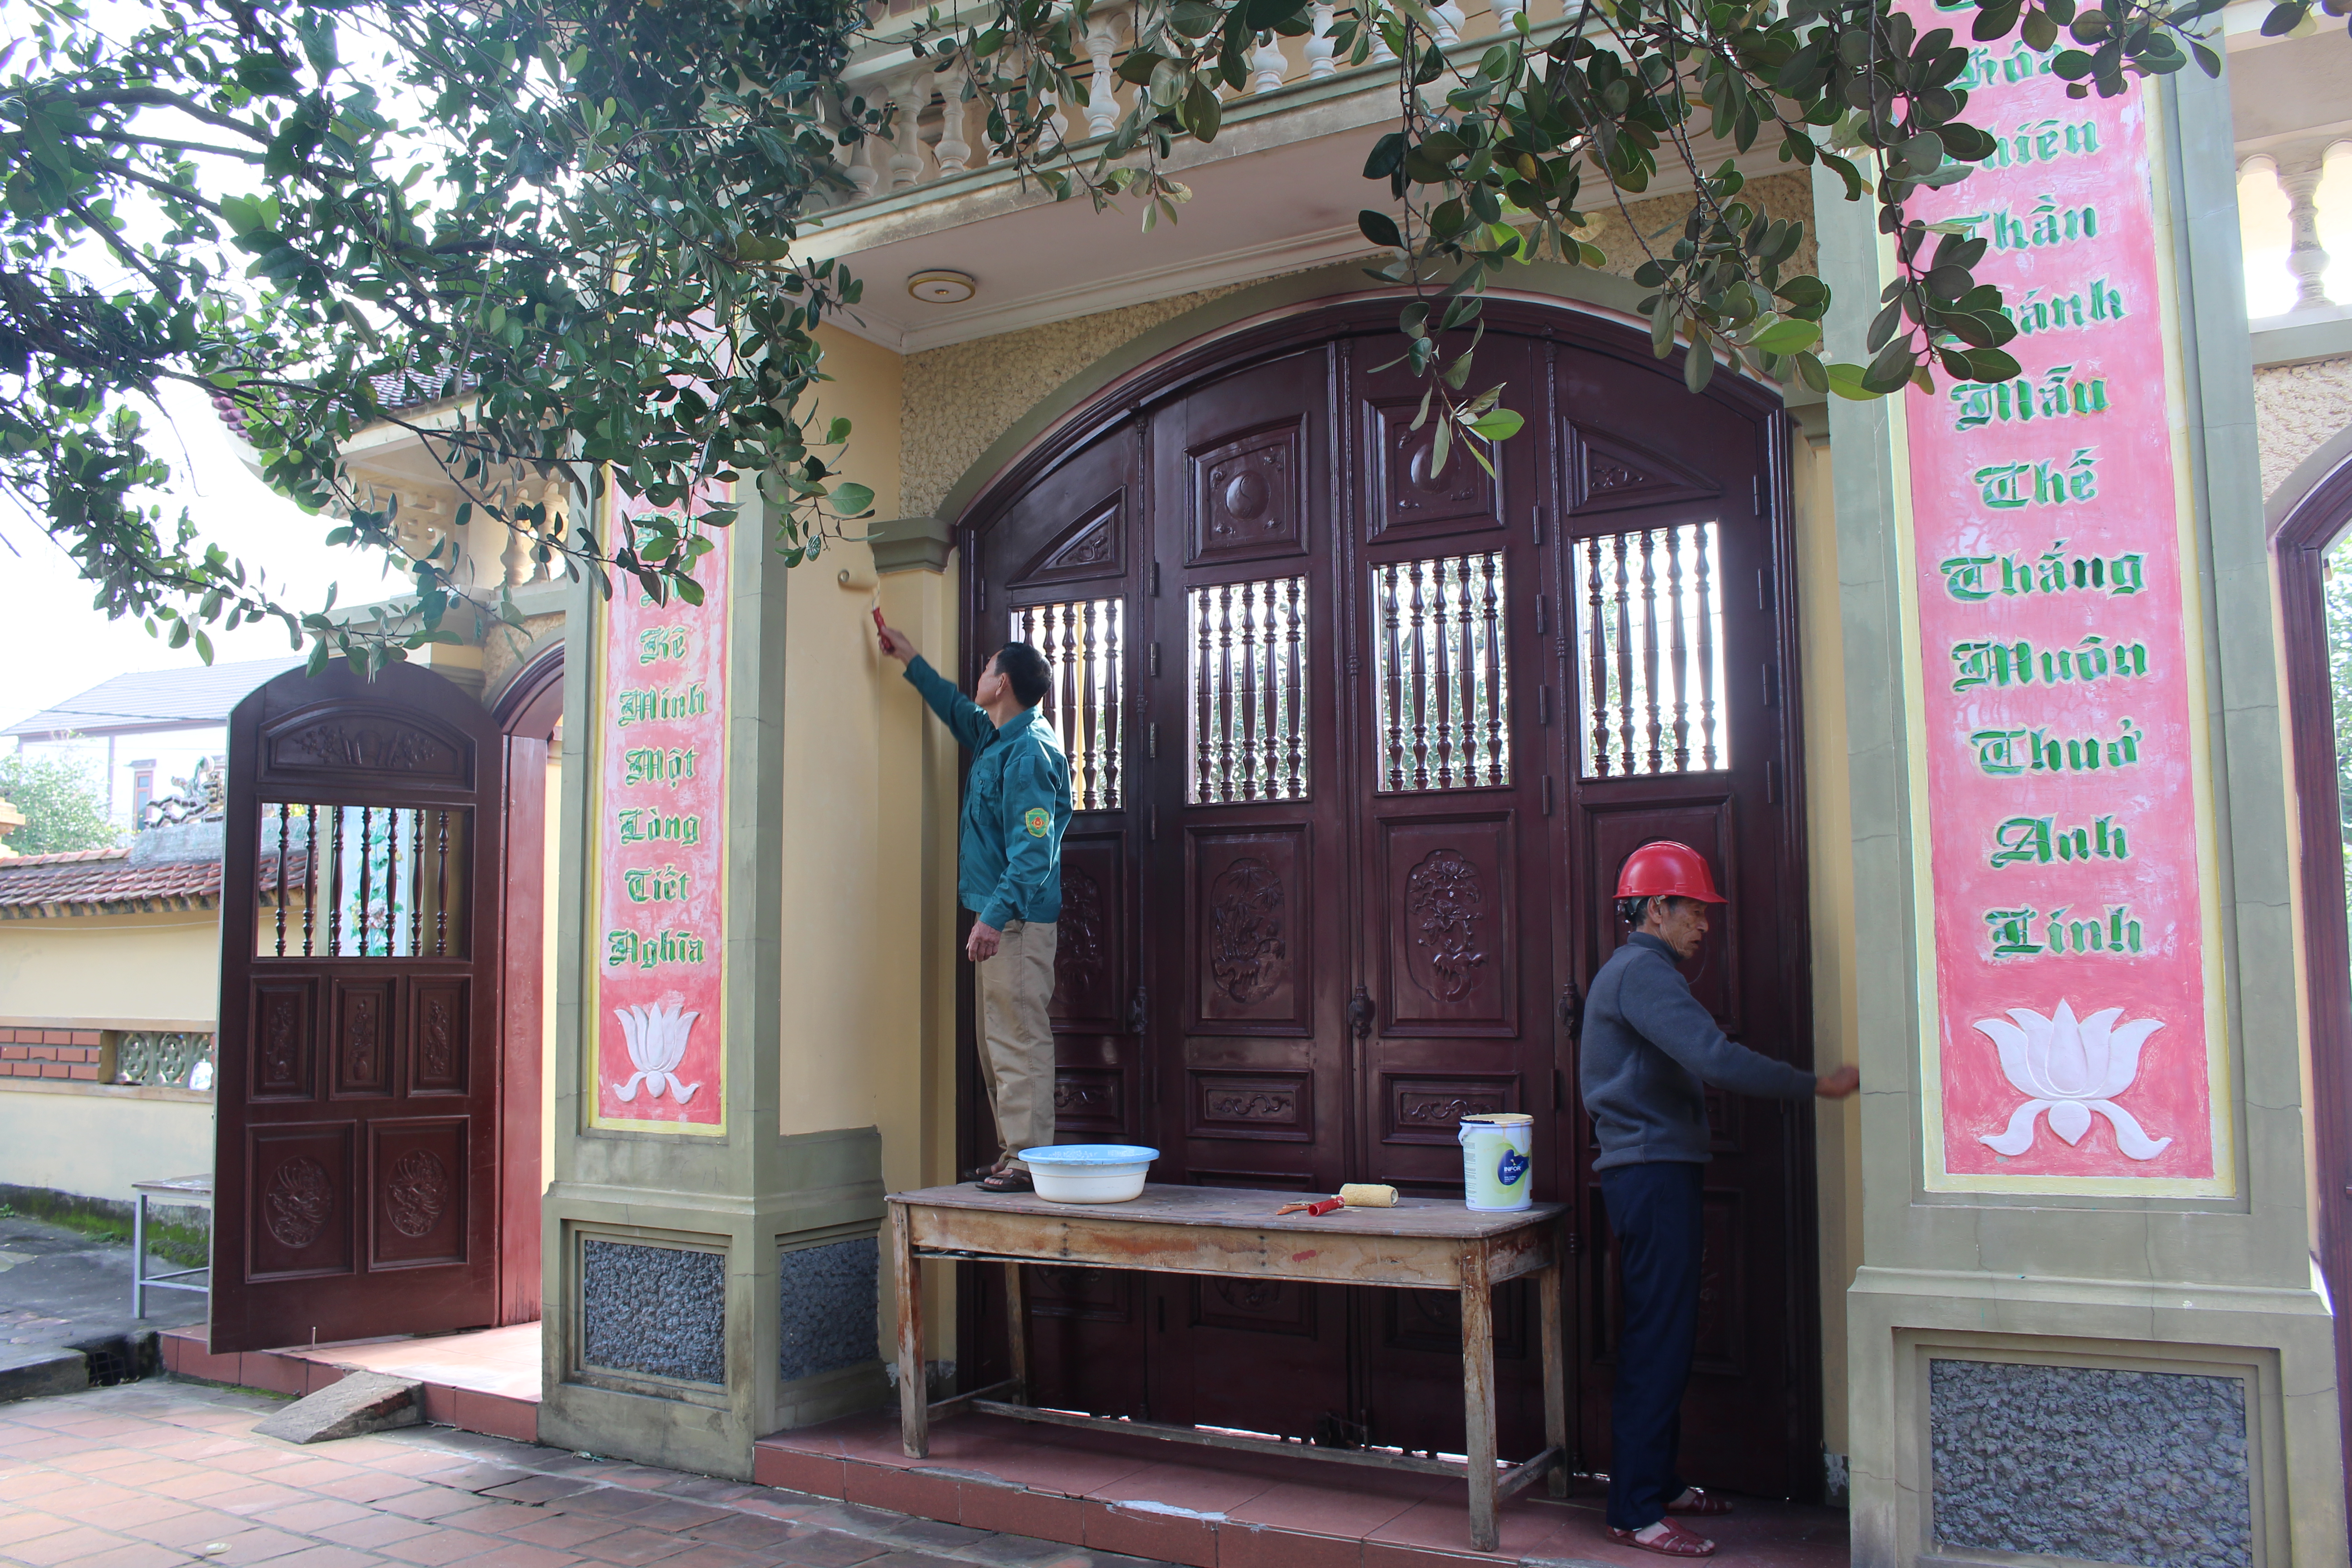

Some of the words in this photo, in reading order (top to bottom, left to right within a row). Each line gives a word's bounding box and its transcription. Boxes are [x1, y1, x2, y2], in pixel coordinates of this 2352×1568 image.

[1942, 119, 2102, 170] hiên
[1942, 277, 2127, 344] ánh
[1950, 364, 2111, 431] Mẫu
[1975, 447, 2098, 509] Thế
[1940, 540, 2145, 601] Thắng
[1952, 635, 2149, 692] Muôn
[617, 683, 705, 727] Minh
[625, 747, 696, 788] Một
[1970, 718, 2144, 776] Thuở
[618, 808, 699, 845] Lòng
[1991, 814, 2131, 868] Anh
[624, 865, 691, 902] Tiết
[607, 930, 704, 969] Nghĩa
[1985, 906, 2144, 959] Linh
